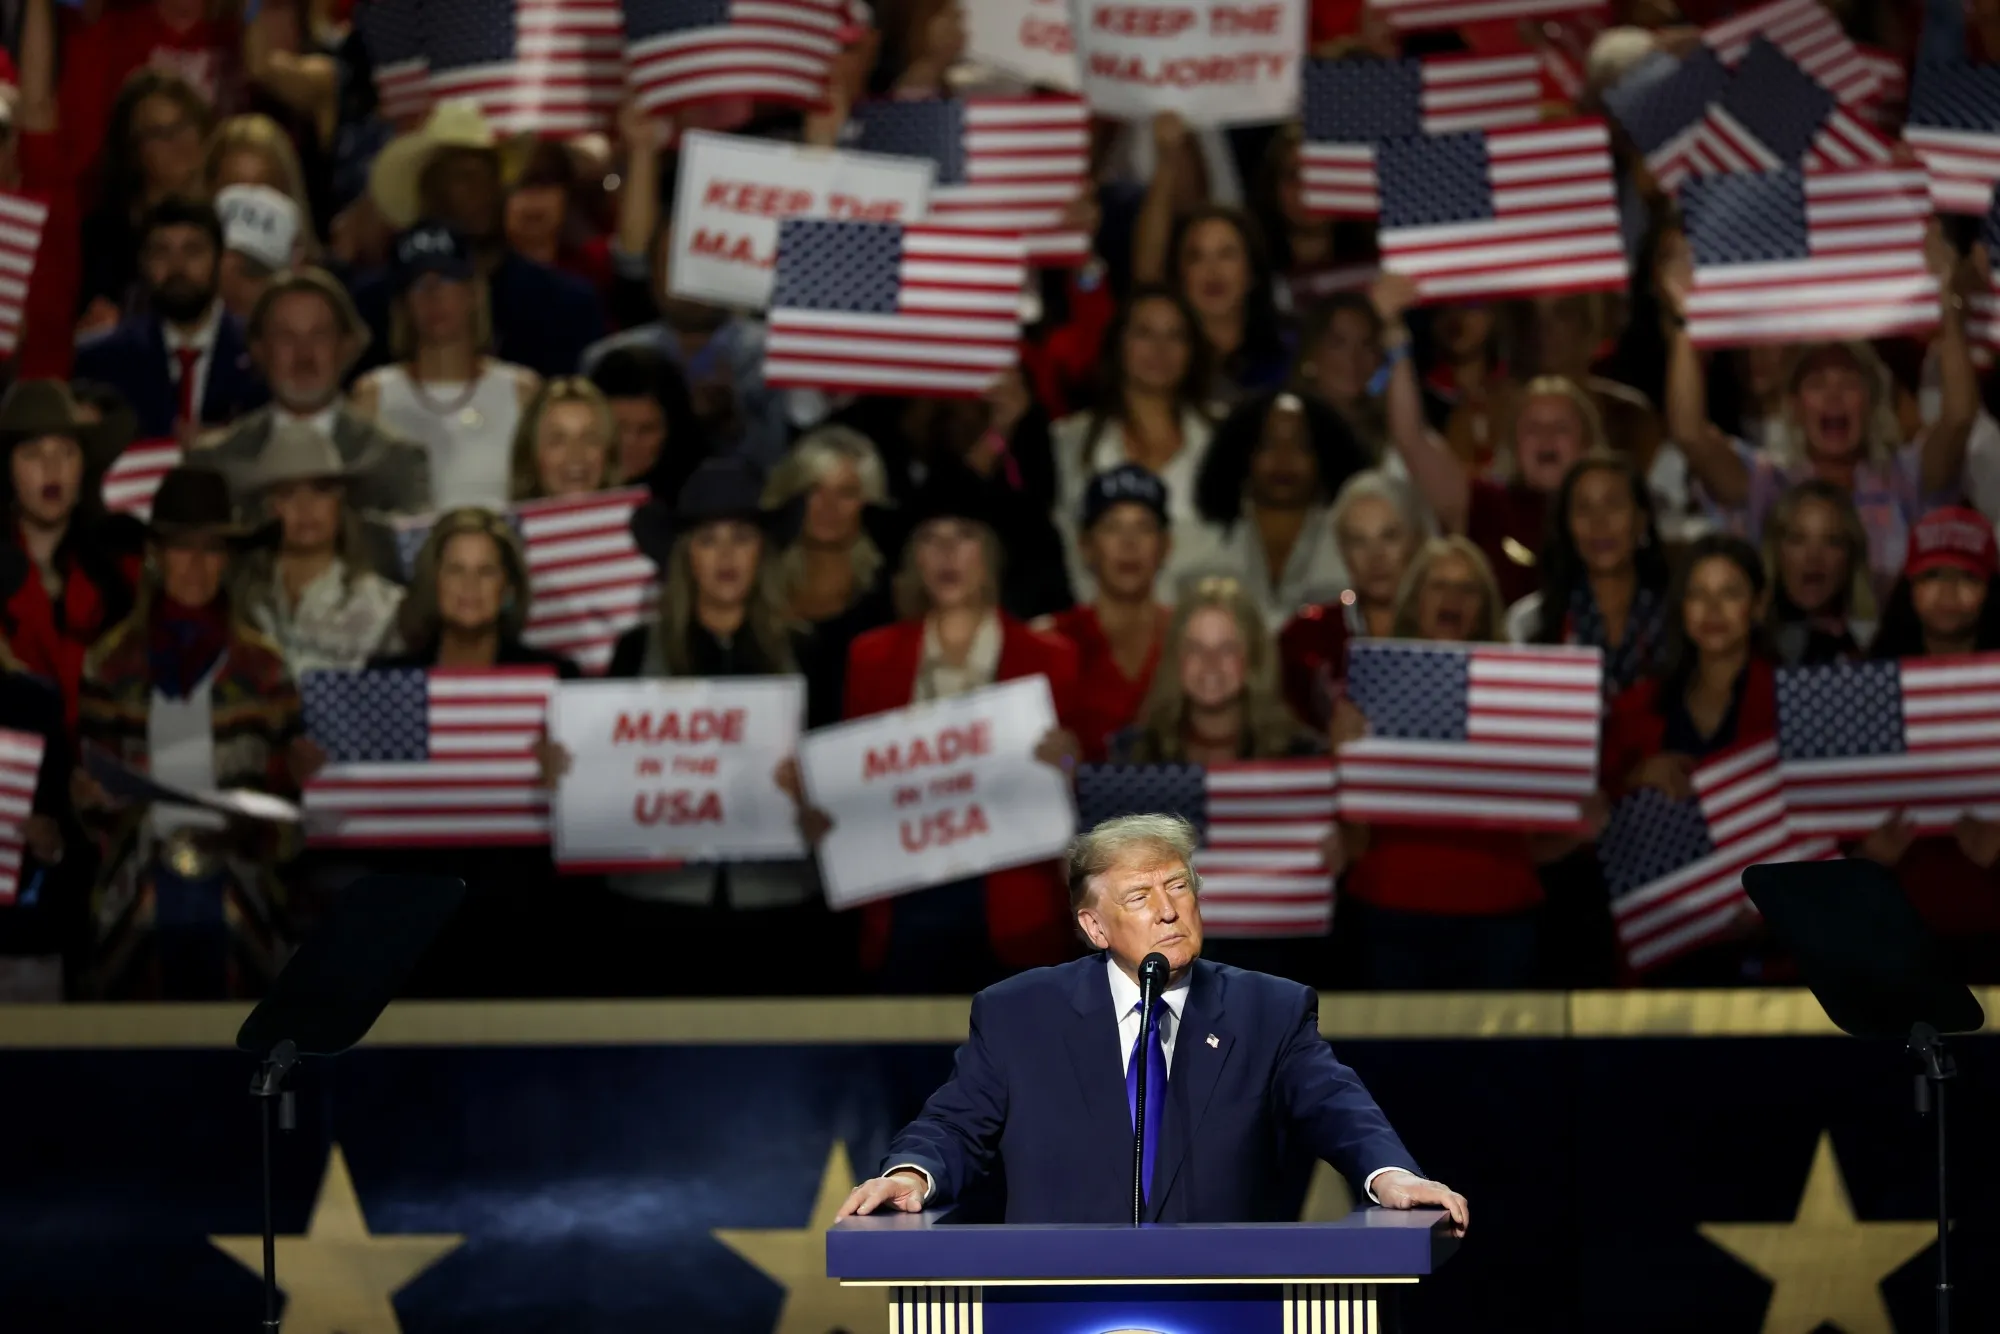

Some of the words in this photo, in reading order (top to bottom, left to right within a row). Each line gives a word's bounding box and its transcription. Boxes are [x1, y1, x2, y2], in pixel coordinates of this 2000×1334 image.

[1019, 18, 1075, 54] US
[1093, 5, 1196, 37] KEEP
[1209, 5, 1284, 35] THE
[1088, 51, 1285, 87] MAJORITY
[704, 177, 814, 217] KEEP
[826, 193, 903, 222] THE
[612, 706, 747, 745] MADE
[636, 757, 663, 776] IN
[672, 755, 719, 776] THE
[862, 719, 991, 782] MADE
[928, 772, 976, 797] THE
[633, 789, 724, 826] USA
[899, 802, 989, 854] USA
